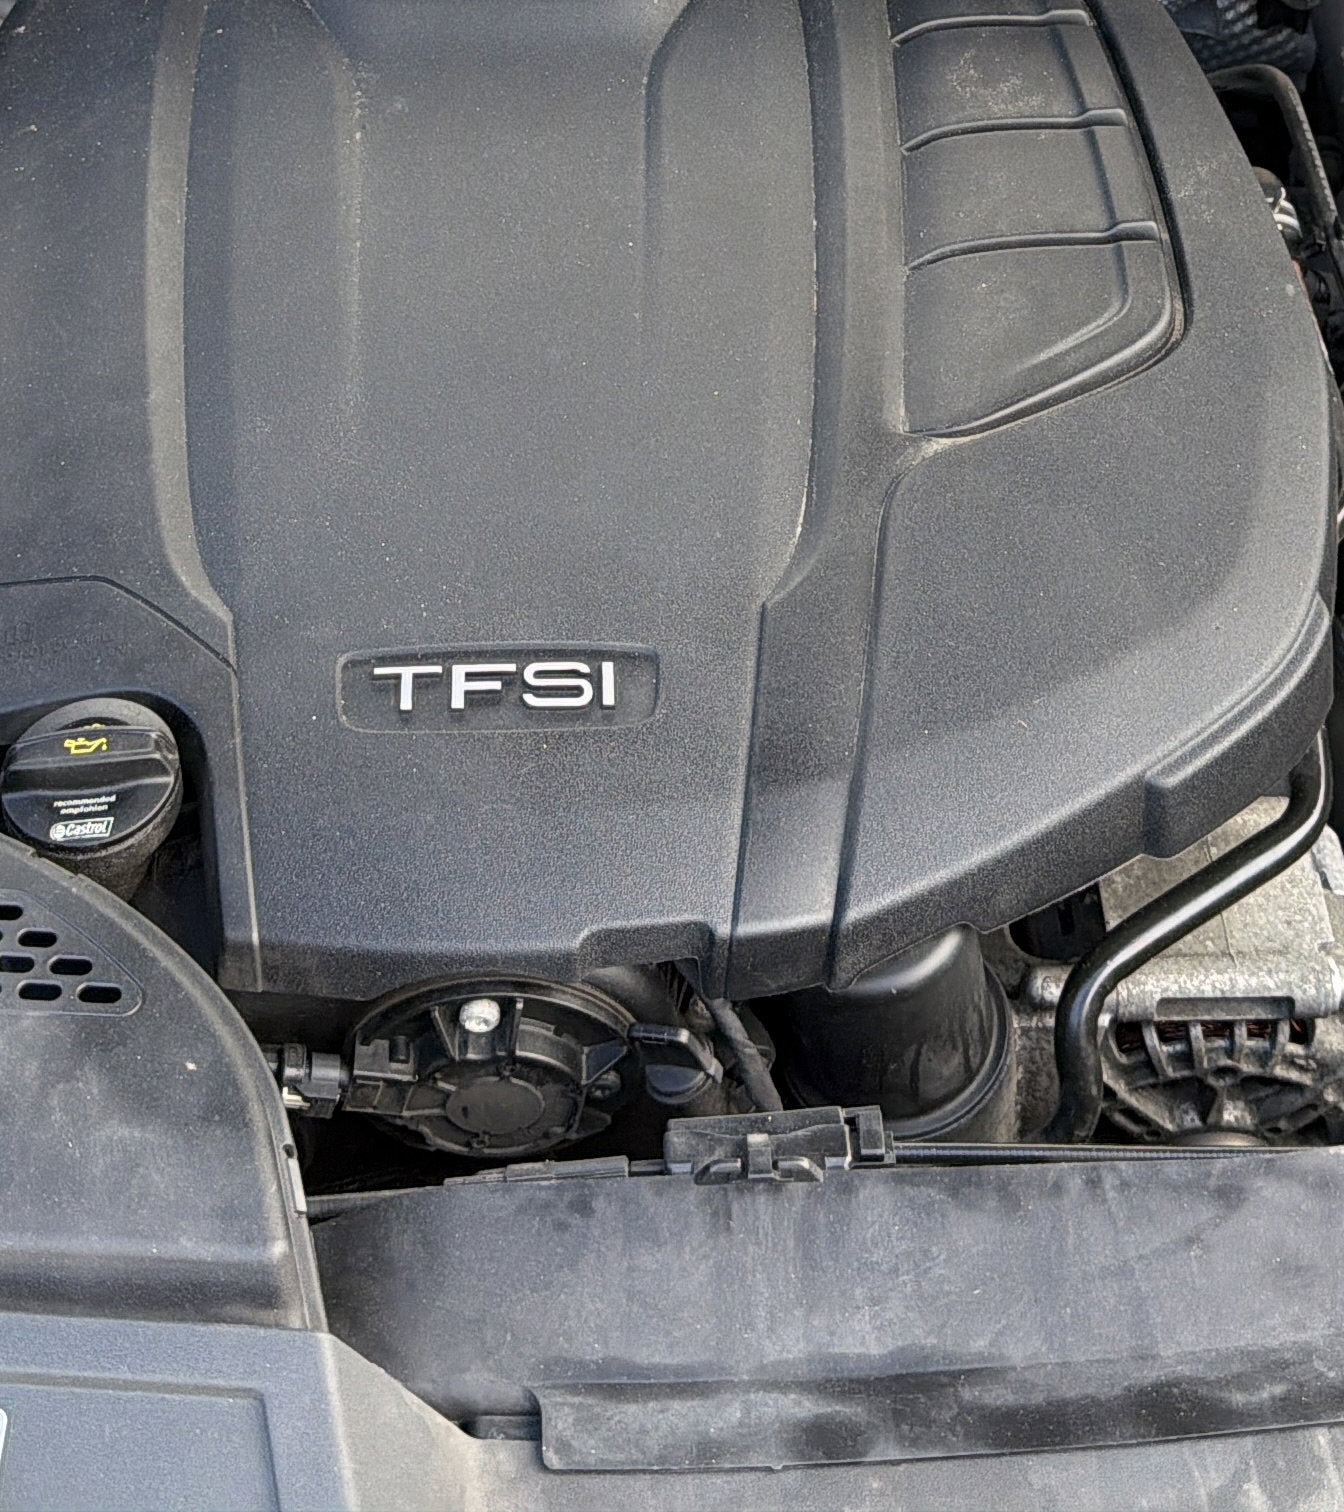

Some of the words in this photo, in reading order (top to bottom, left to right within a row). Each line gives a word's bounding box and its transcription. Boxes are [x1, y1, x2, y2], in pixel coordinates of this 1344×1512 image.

[373, 661, 616, 711] TFSI
[53, 794, 117, 808] recommended
[65, 820, 108, 837] Castrol
